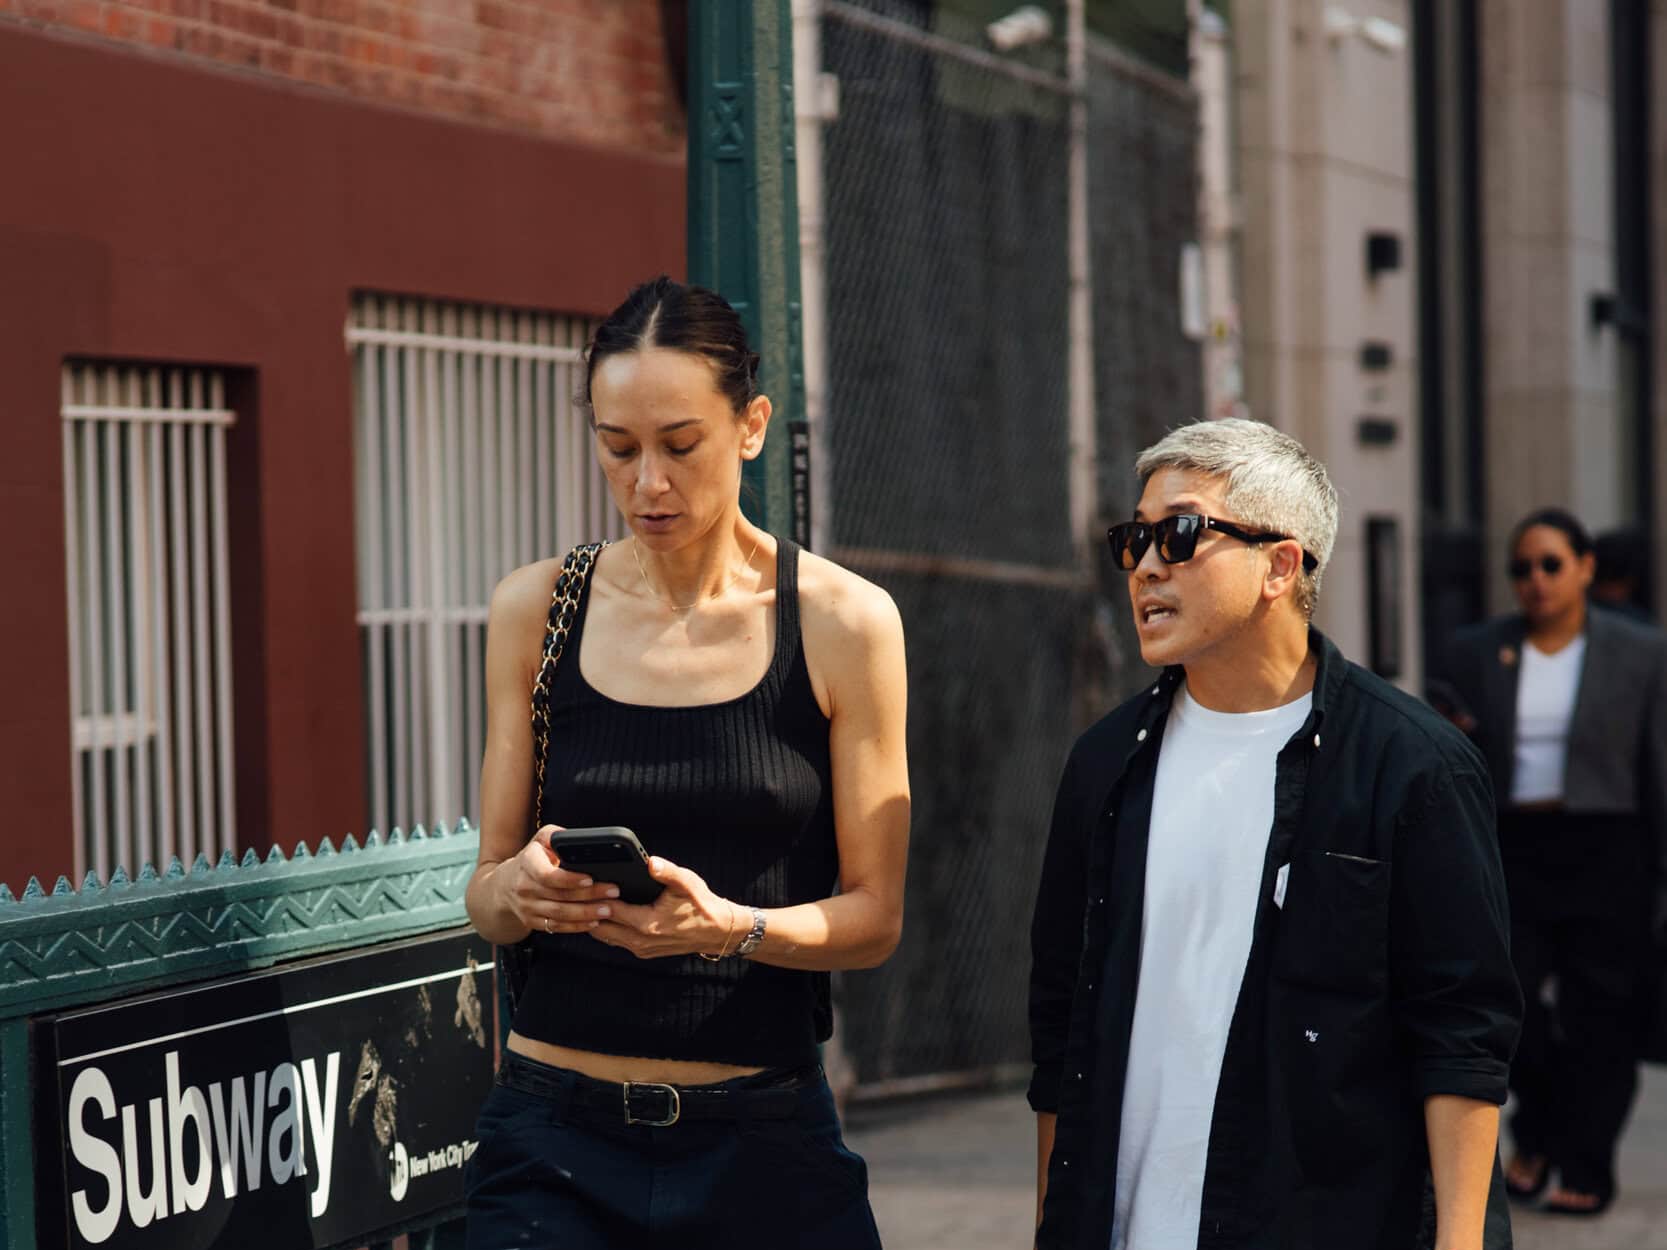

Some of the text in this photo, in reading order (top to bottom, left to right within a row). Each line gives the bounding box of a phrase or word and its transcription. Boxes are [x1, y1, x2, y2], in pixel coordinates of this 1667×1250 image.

[68, 1051, 341, 1244] Subway
[410, 1156, 428, 1178] New
[428, 1148, 447, 1172] York
[447, 1145, 464, 1169] City
